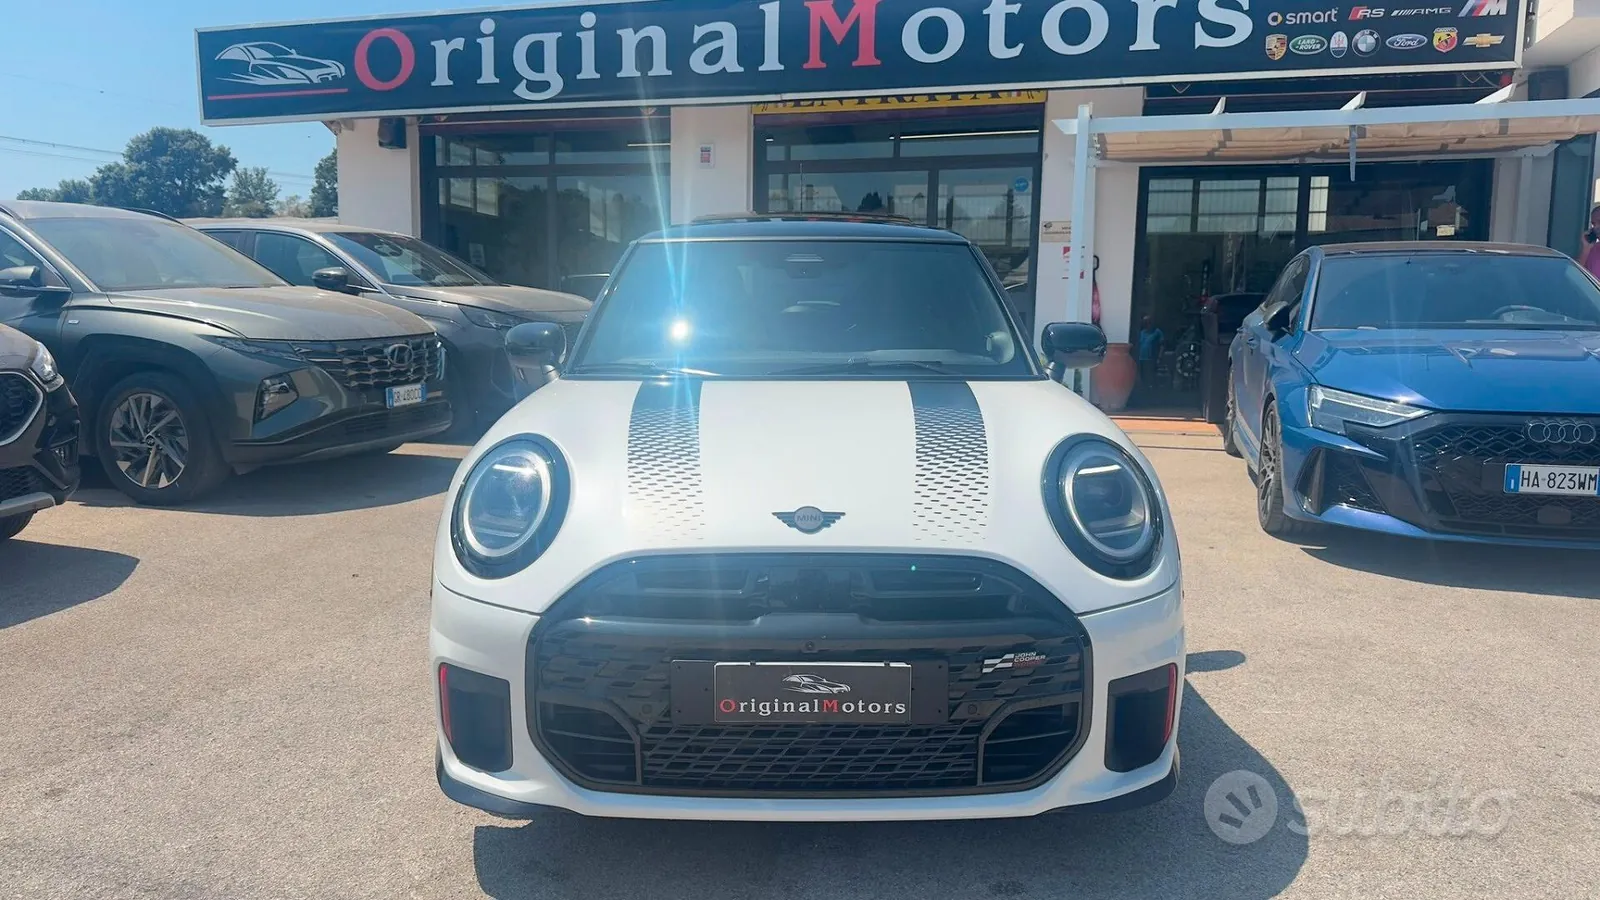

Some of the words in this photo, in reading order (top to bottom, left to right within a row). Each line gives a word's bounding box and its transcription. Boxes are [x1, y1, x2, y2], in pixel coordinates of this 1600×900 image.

[1286, 8, 1338, 24] smart
[1357, 8, 1385, 18] RS
[1393, 36, 1419, 47] Ford
[797, 513, 823, 521] MINI
[1014, 655, 1046, 663] COOPER
